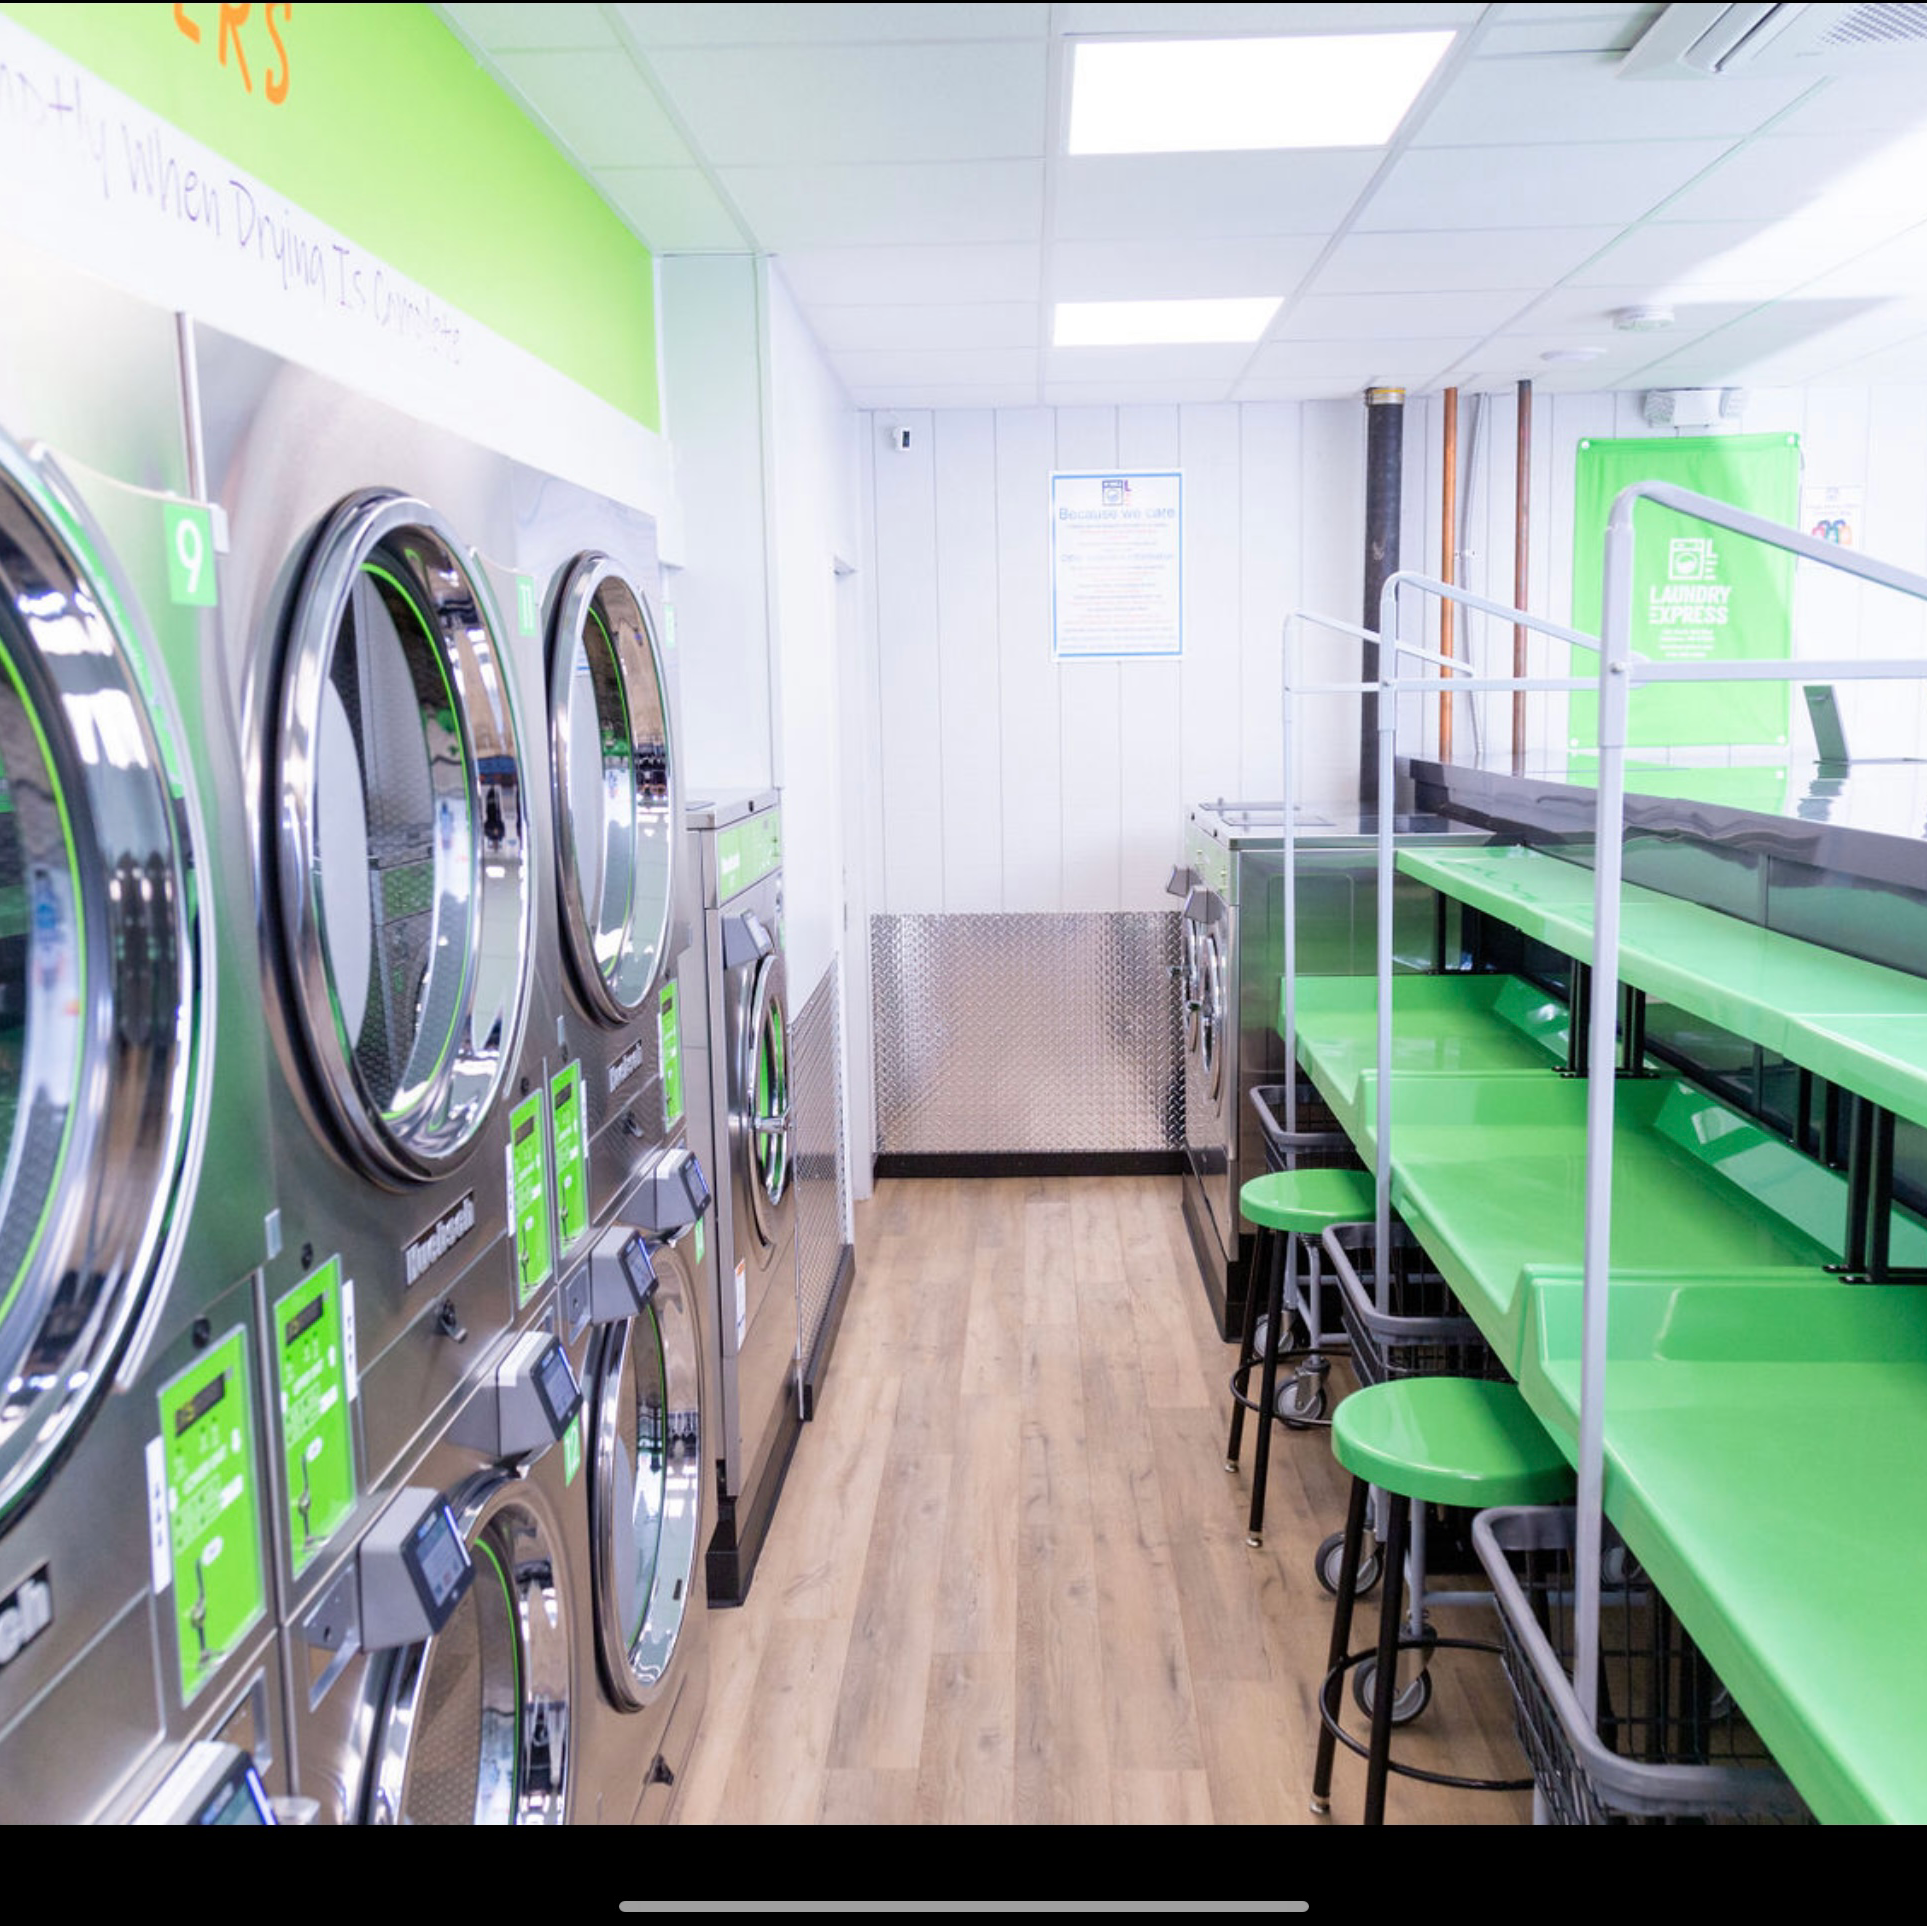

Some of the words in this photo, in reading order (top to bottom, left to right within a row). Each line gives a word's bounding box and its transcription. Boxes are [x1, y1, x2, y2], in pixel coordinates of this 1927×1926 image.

[121, 122, 221, 236] When
[229, 180, 327, 304] Drying
[332, 244, 367, 312] Is
[1059, 508, 1118, 520] Because
[176, 518, 203, 594] 9
[1649, 585, 1733, 604] LAUNDRY
[1648, 606, 1730, 625] EXPRESS
